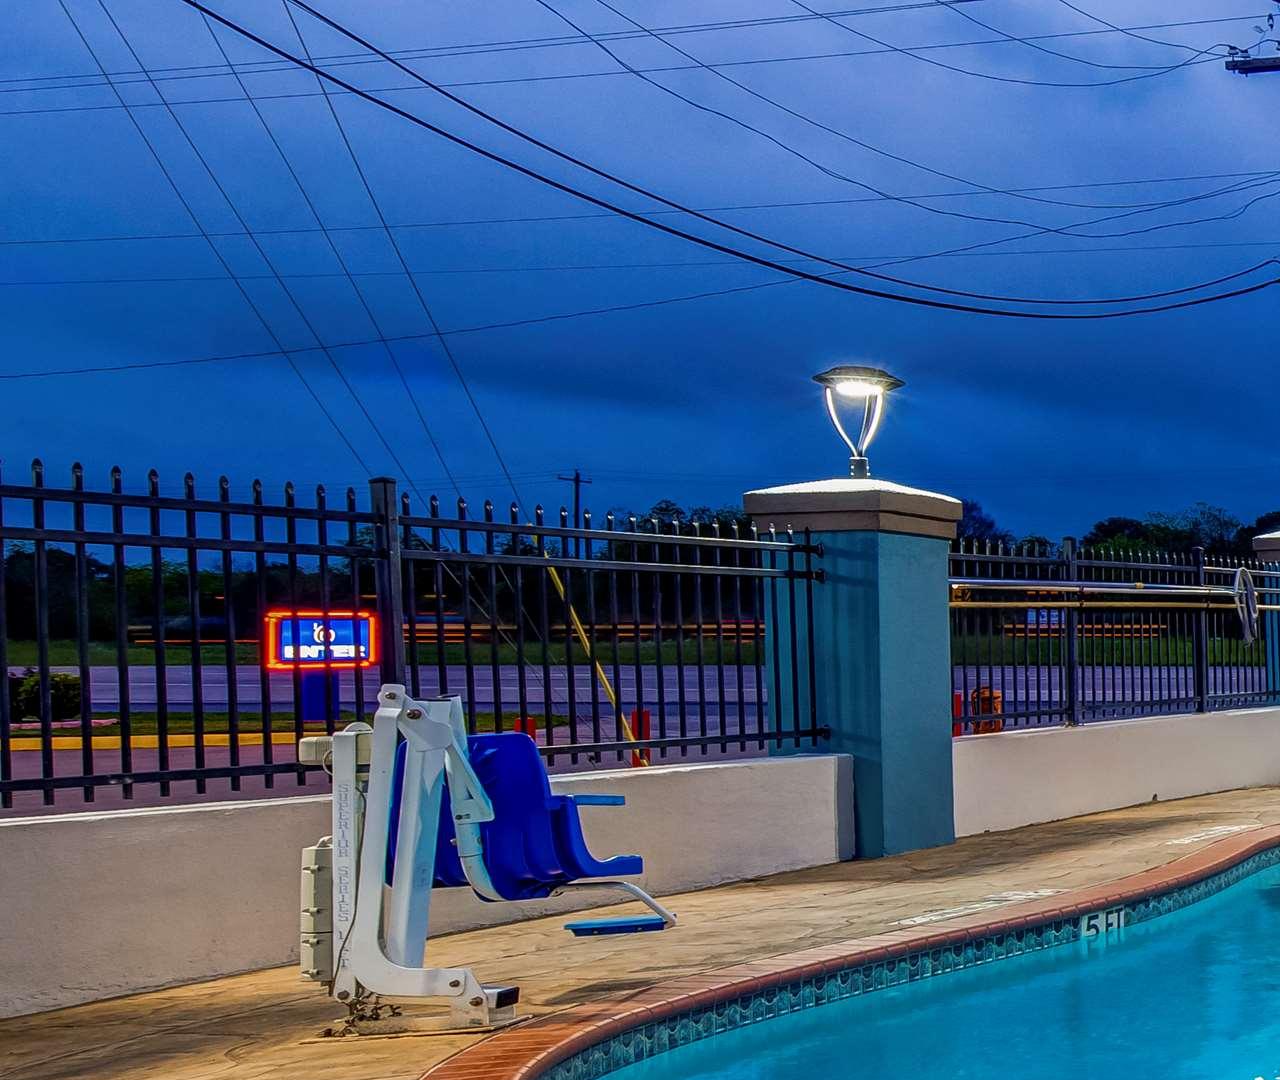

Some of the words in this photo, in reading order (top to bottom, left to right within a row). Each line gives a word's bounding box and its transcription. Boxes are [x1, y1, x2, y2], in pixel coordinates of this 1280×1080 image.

[338, 784, 350, 857] SUPERIOR
[338, 866, 349, 922] SERIES
[1086, 914, 1100, 938] 5
[1105, 906, 1123, 933] FT
